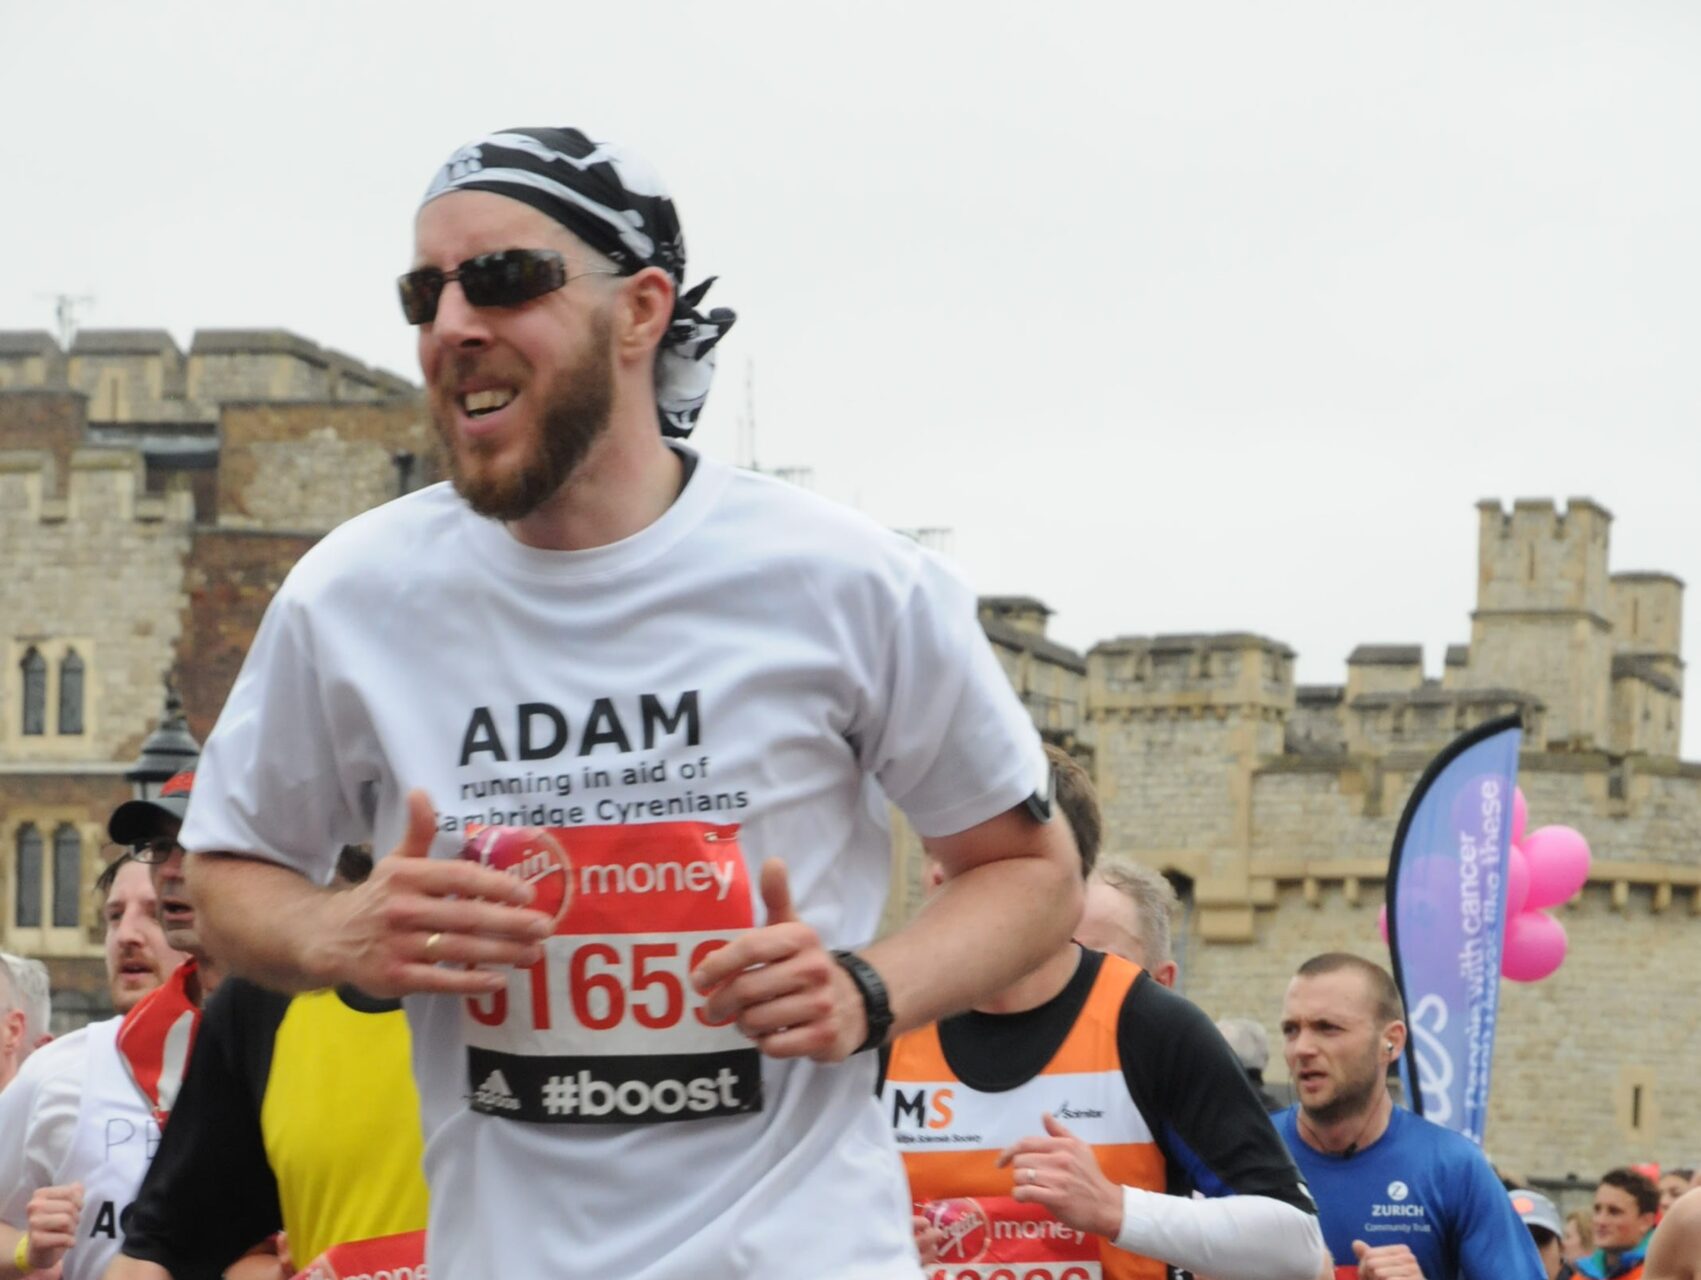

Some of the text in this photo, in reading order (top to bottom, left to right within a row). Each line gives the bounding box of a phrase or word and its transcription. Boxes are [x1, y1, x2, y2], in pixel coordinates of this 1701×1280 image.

[457, 690, 702, 766] ADAM
[461, 757, 710, 801] running in aid of
[435, 789, 749, 832] ambridge Cyrenians
[1481, 780, 1501, 866] these
[580, 859, 734, 900] money
[1460, 831, 1482, 935] cancer
[541, 1068, 739, 1116] #boost
[892, 1088, 955, 1130] MS
[1371, 1204, 1424, 1217] ZURICH
